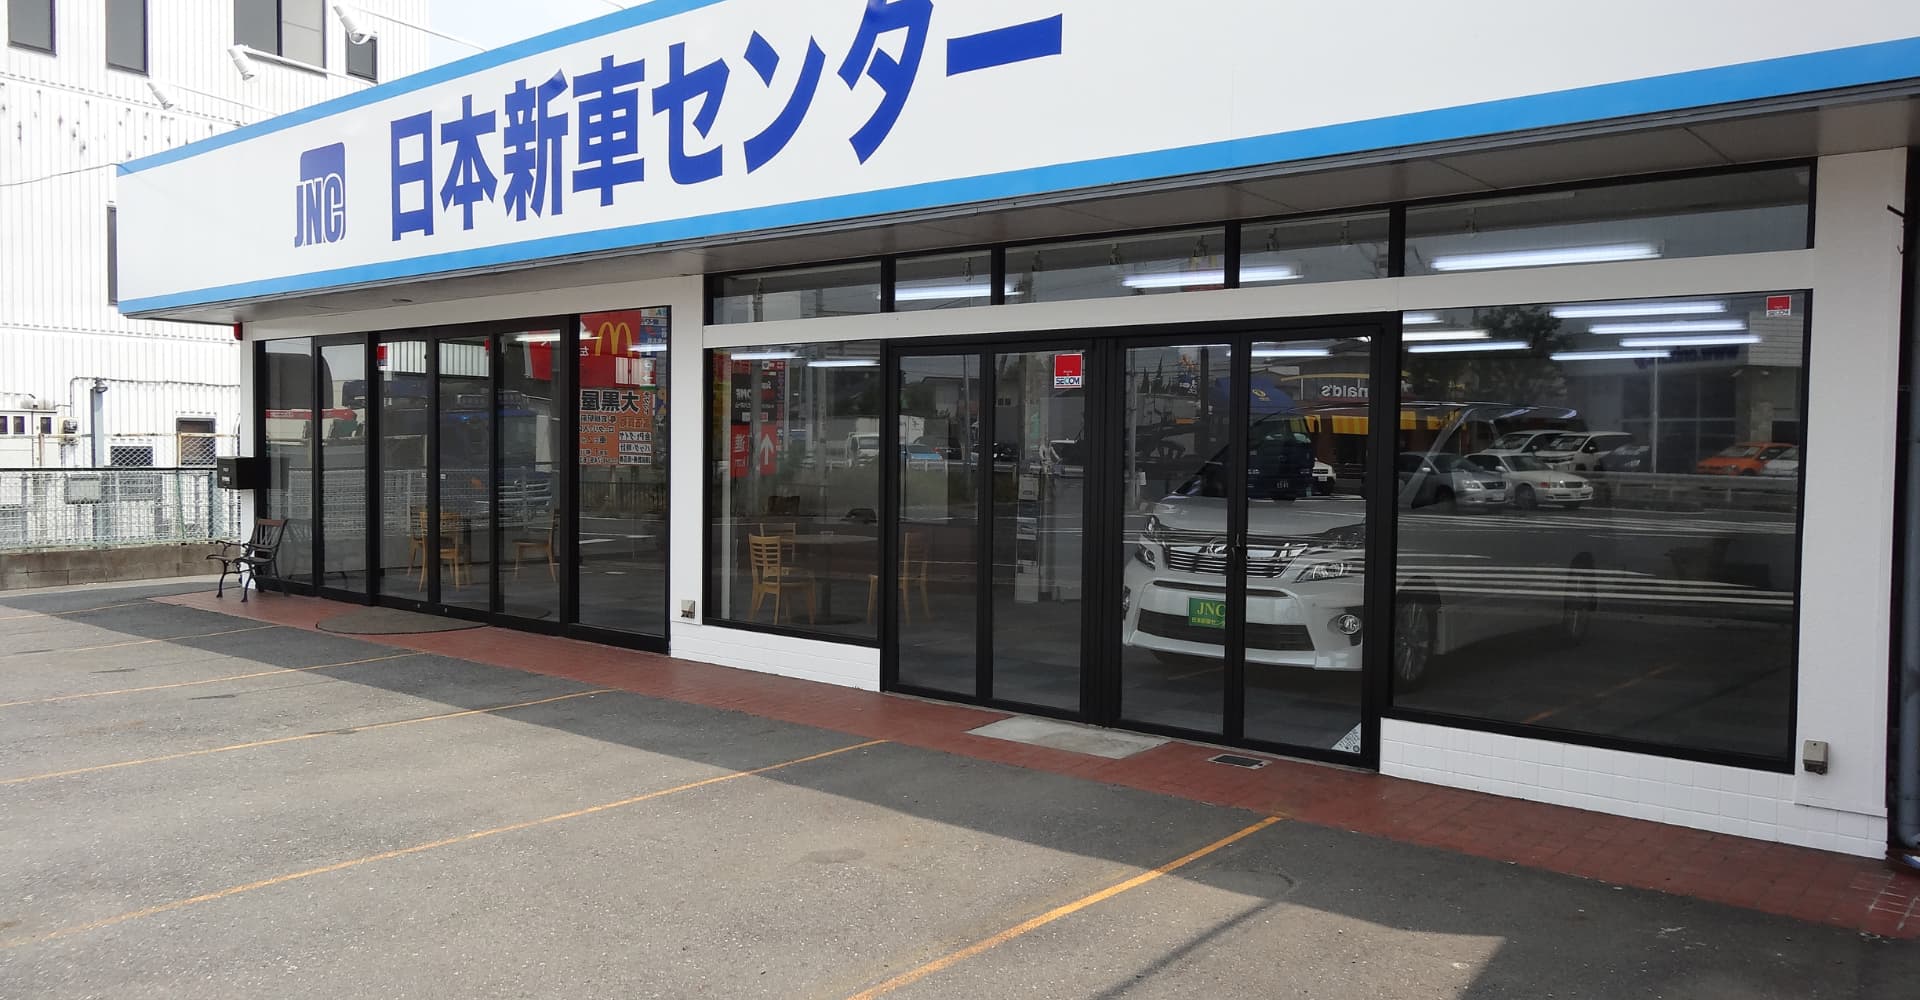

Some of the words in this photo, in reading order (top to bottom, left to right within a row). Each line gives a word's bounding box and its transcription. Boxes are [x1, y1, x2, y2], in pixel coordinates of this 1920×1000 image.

[391, 0, 1063, 241] 日本新車センター
[294, 172, 346, 248] JNC
[1056, 376, 1080, 385] SECOM
[1197, 602, 1226, 617] JNC
